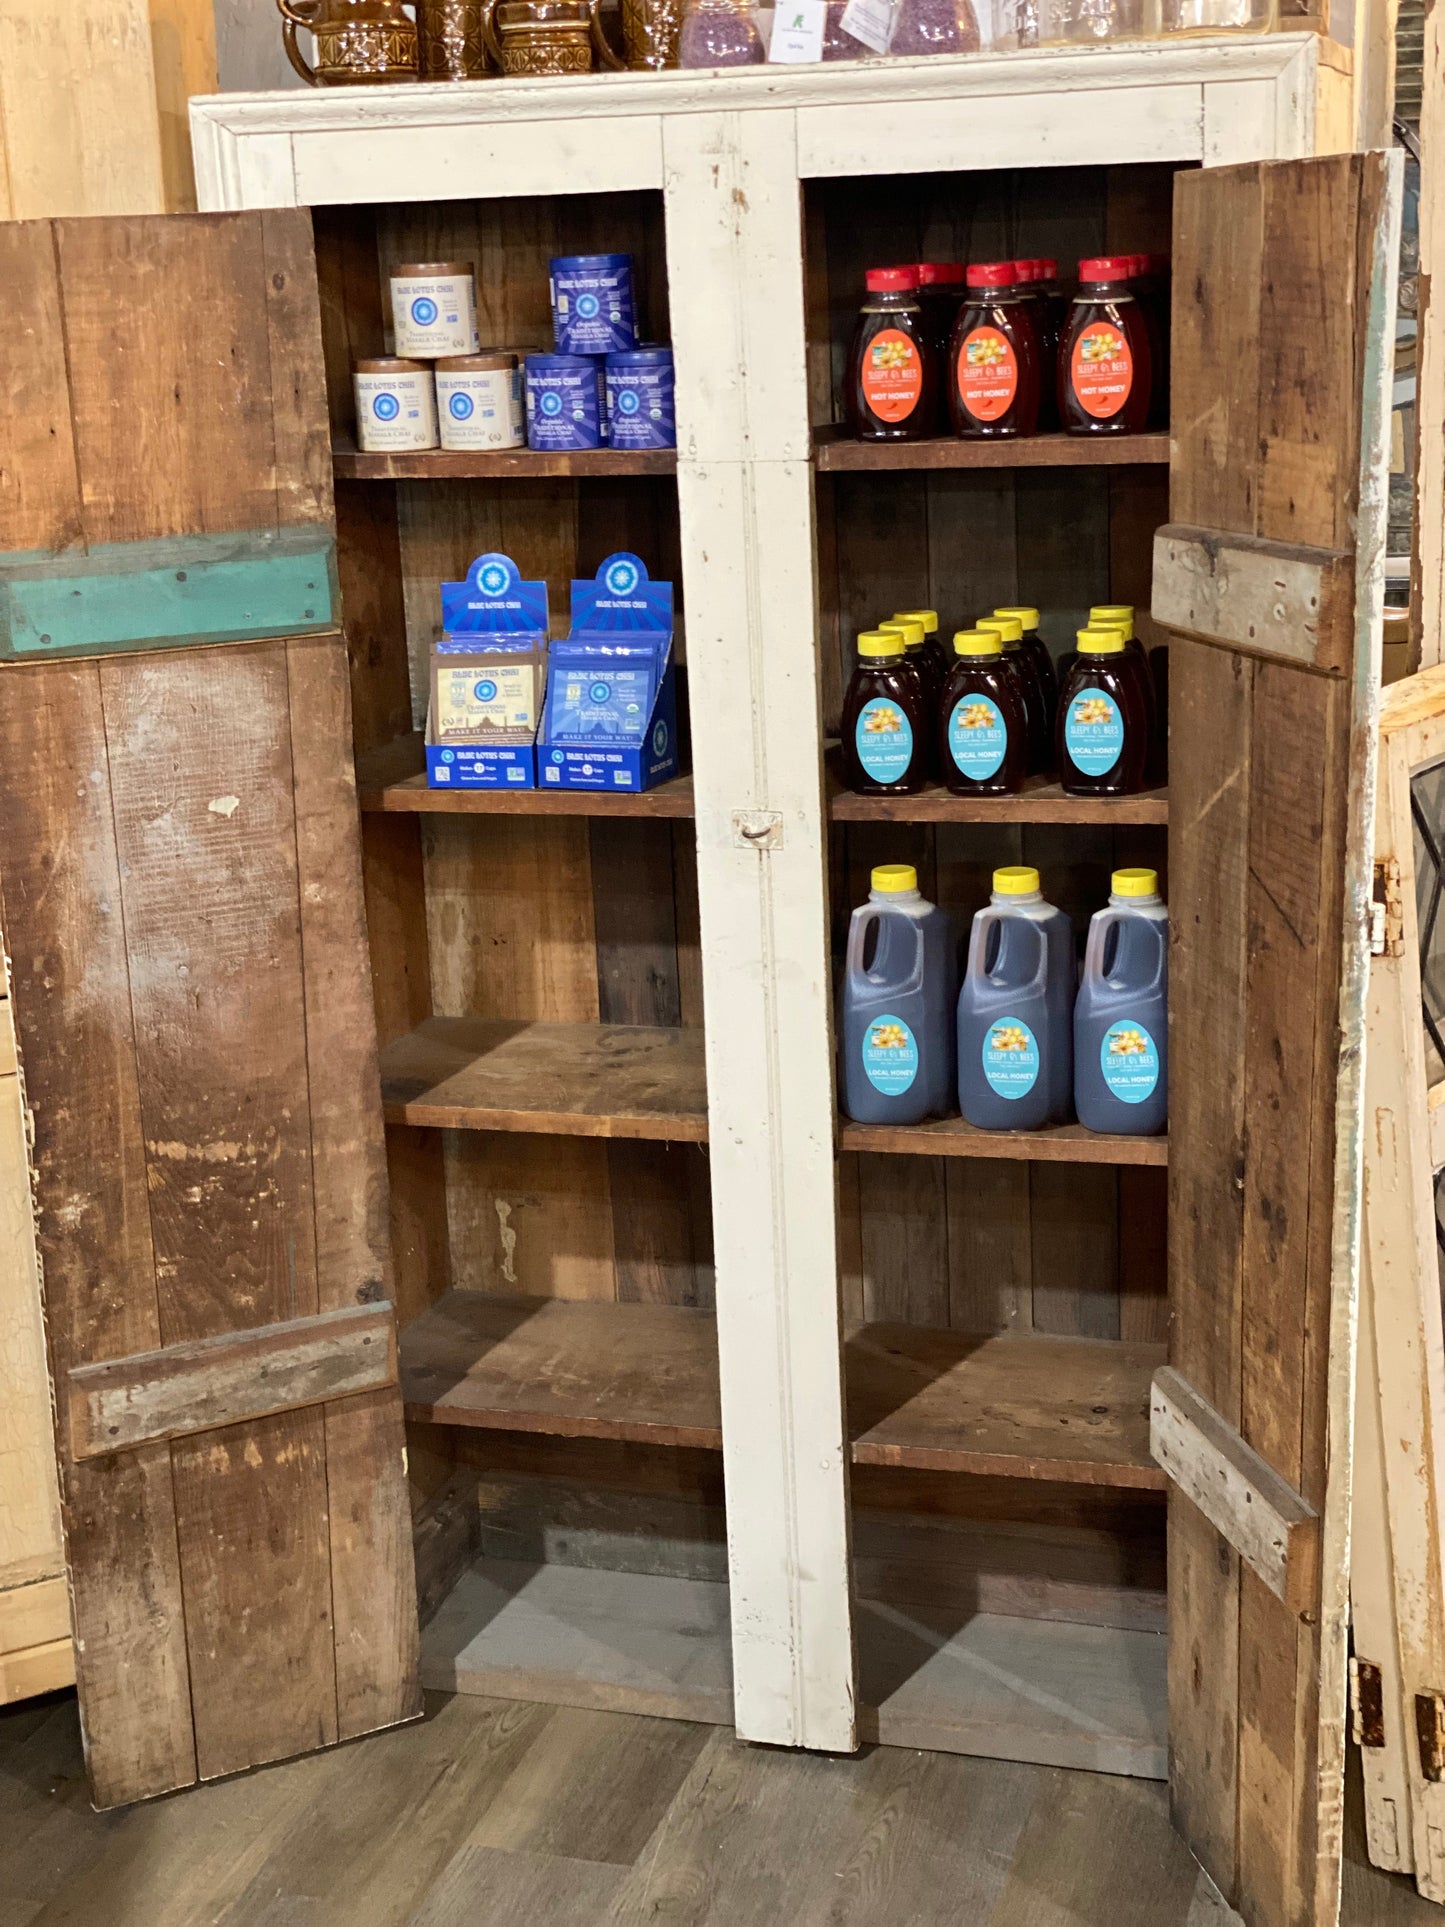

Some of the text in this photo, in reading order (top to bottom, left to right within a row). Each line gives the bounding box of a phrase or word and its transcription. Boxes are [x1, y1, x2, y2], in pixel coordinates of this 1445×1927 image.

[967, 389, 1010, 399] HOT HONEY
[1081, 384, 1126, 395] HOT HONEY
[871, 392, 915, 401] HOT HONEY
[954, 750, 1002, 759] LOCAL HONEY
[1093, 746, 1119, 754] HONEY
[862, 754, 909, 763] LOCAL HONEY
[987, 1071, 1034, 1080] LOCAL HONEY
[1130, 1075, 1155, 1083] HONEY
